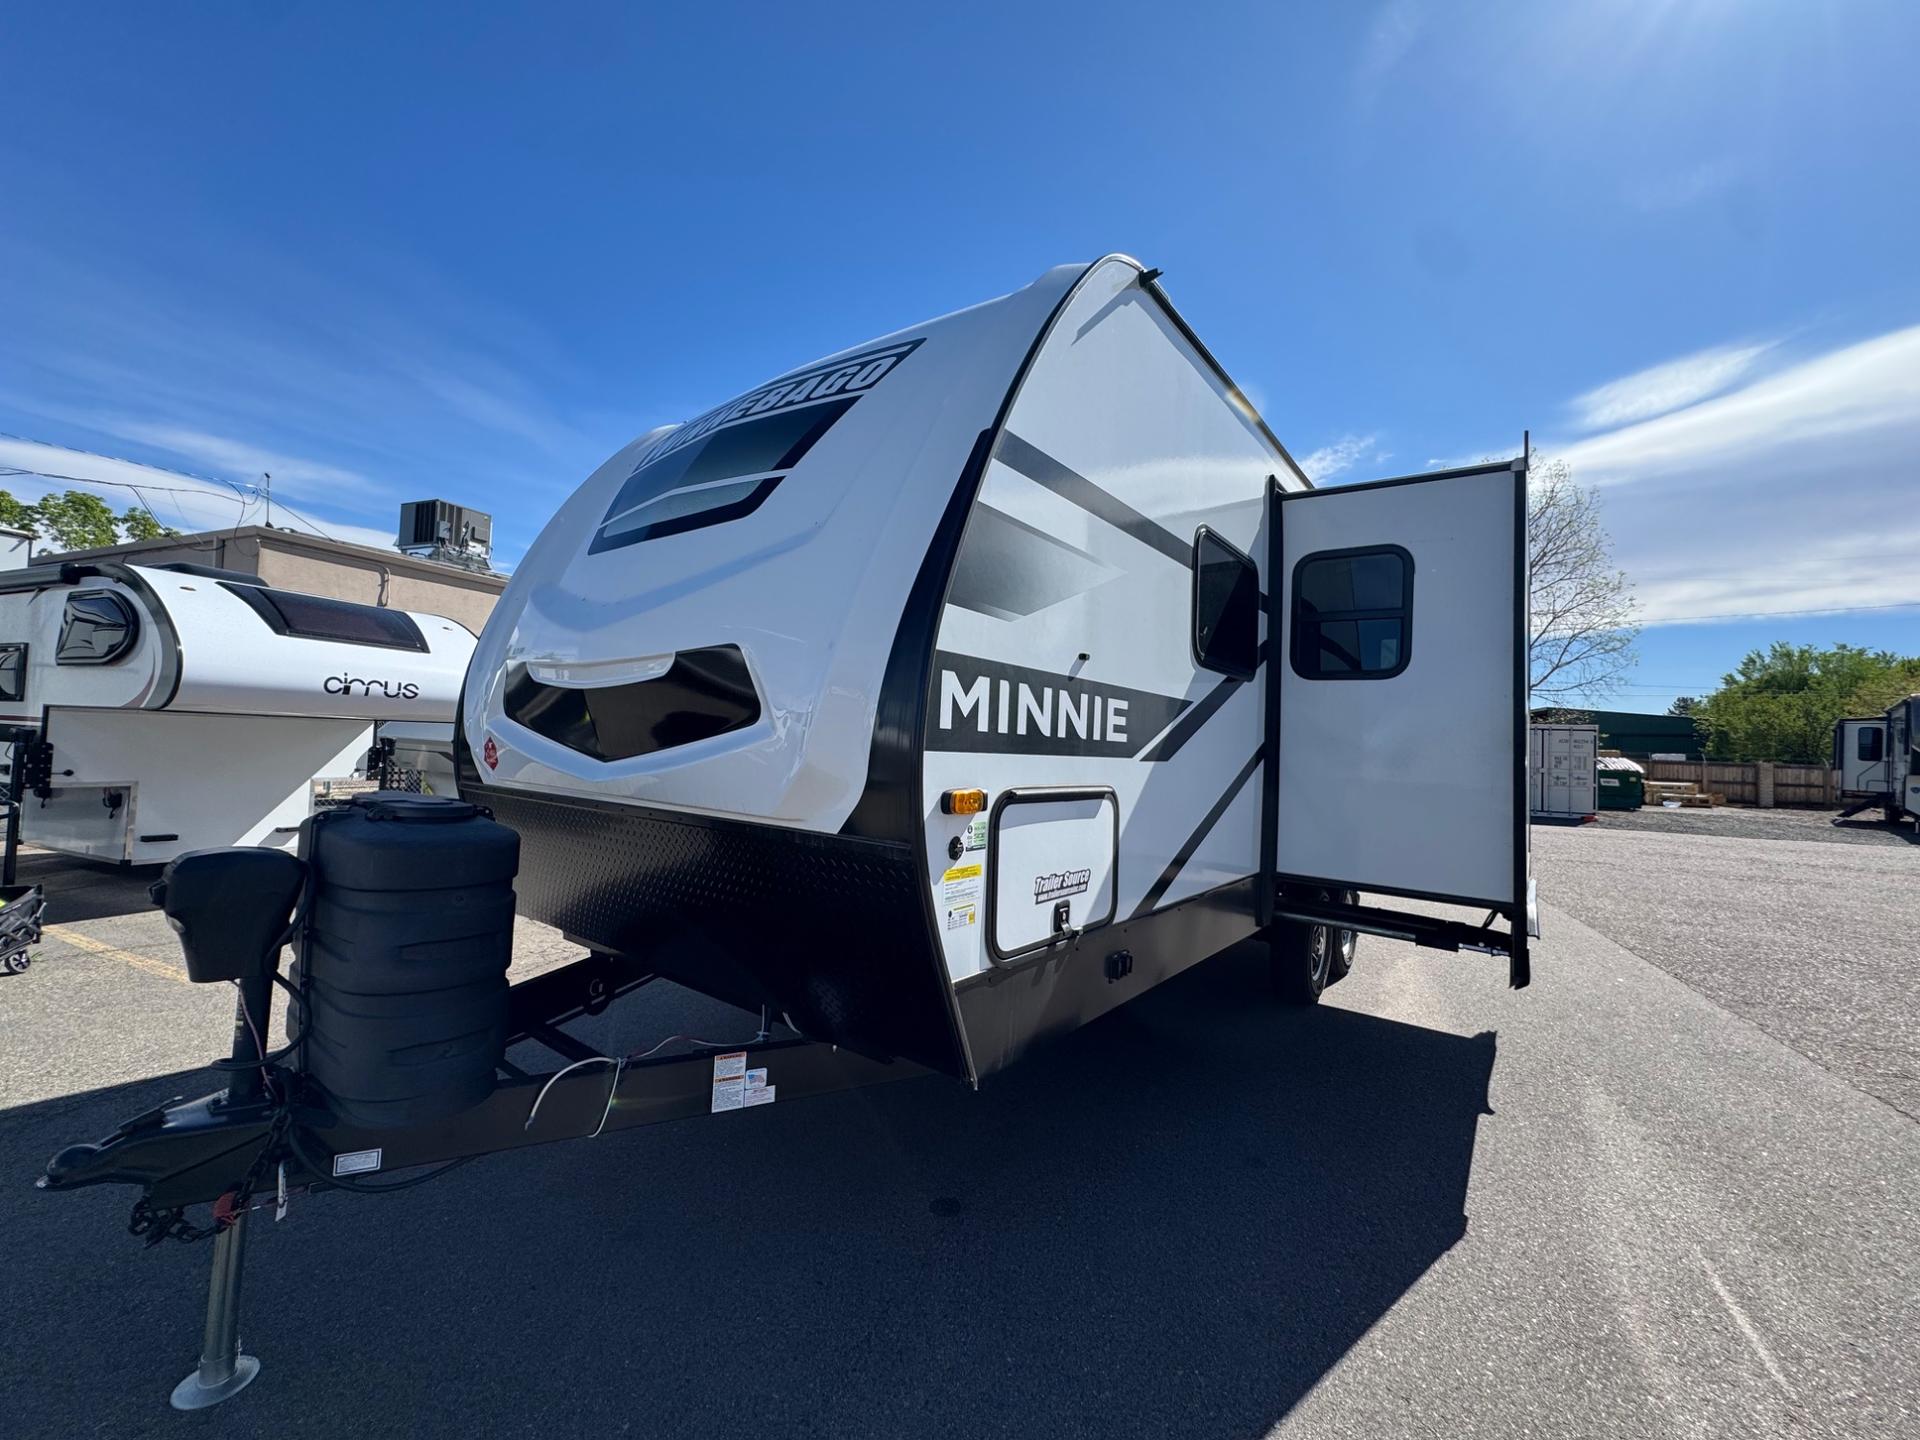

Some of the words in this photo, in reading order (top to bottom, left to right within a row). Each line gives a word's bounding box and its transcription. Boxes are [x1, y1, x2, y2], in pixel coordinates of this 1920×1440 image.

[323, 672, 419, 699] cirrus
[939, 669, 1129, 743] MINNIE
[1034, 874, 1063, 894] Trailer
[1062, 870, 1090, 888] Source
